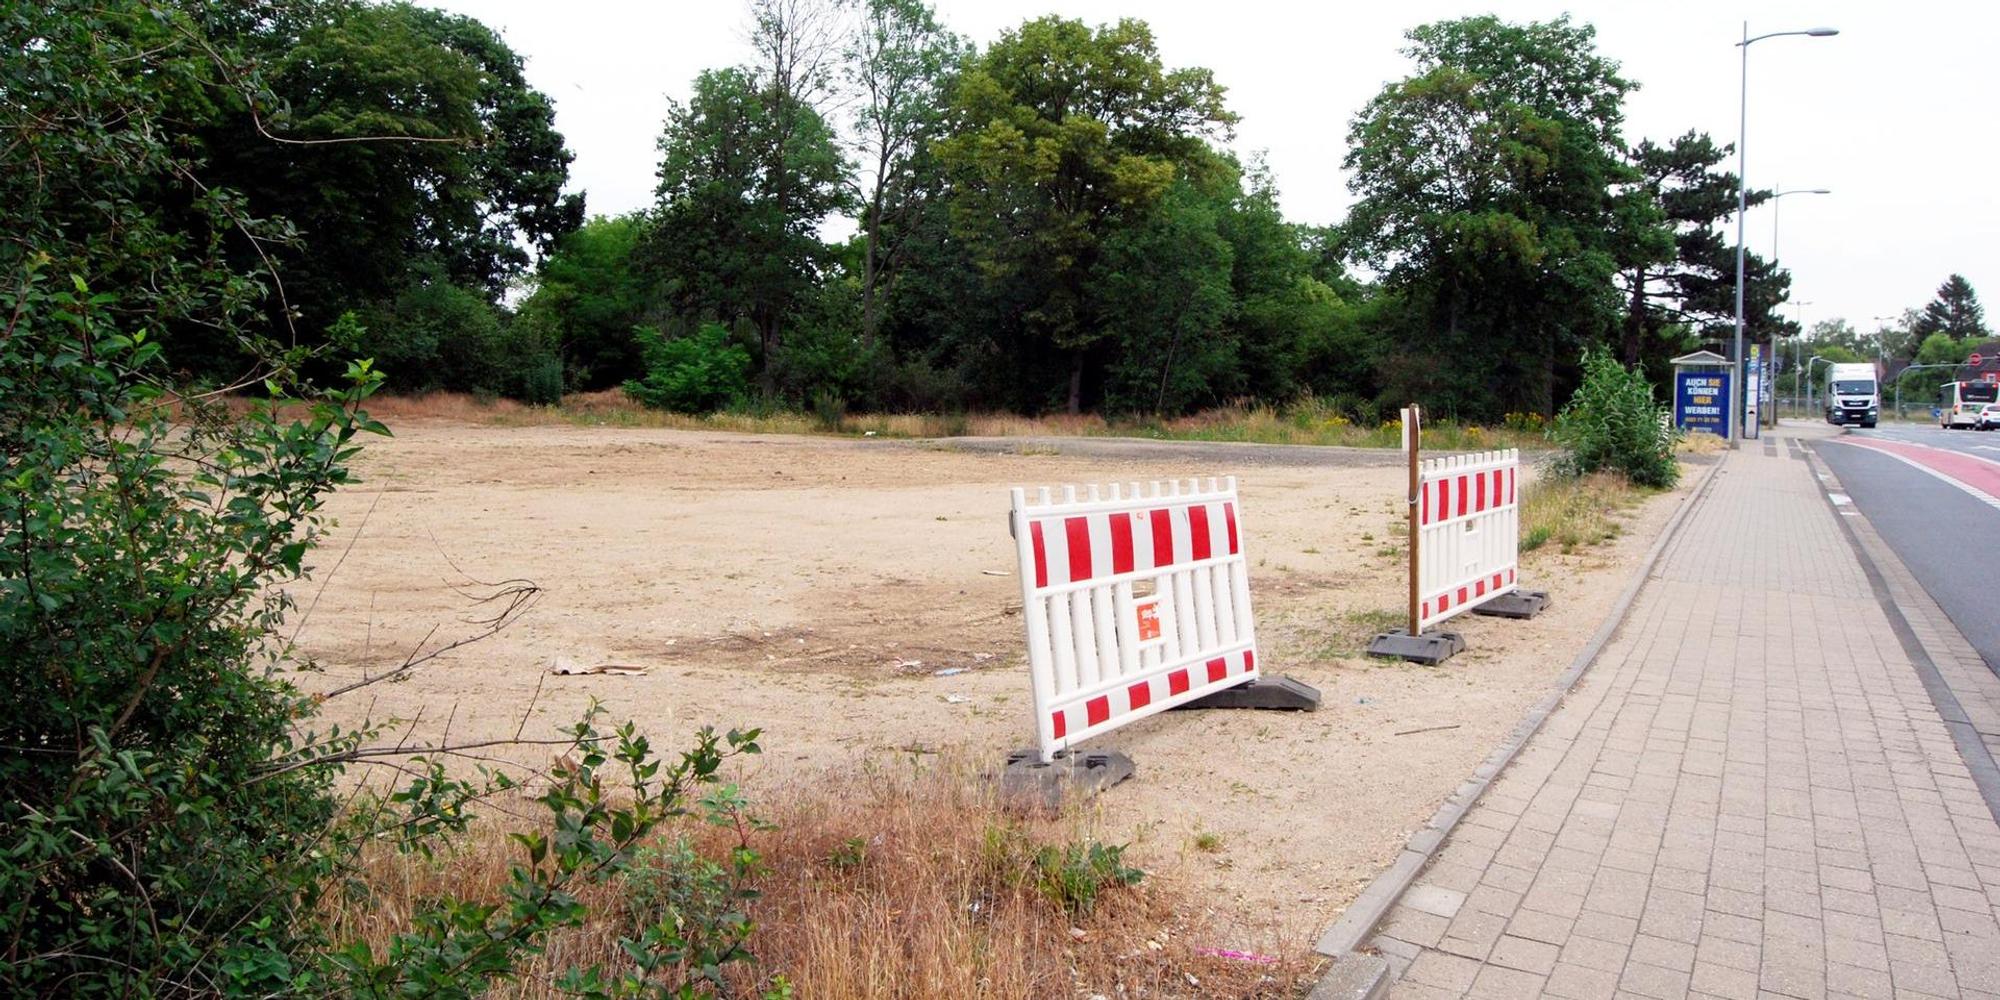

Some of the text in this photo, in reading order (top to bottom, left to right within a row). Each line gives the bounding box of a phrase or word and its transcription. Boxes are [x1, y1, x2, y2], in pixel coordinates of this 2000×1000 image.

[1686, 378, 1721, 387] AUCH SIE
[1687, 386, 1719, 395] KÖNNEN
[1693, 396, 1712, 404] HIER
[1685, 406, 1720, 415] WERBEN!
